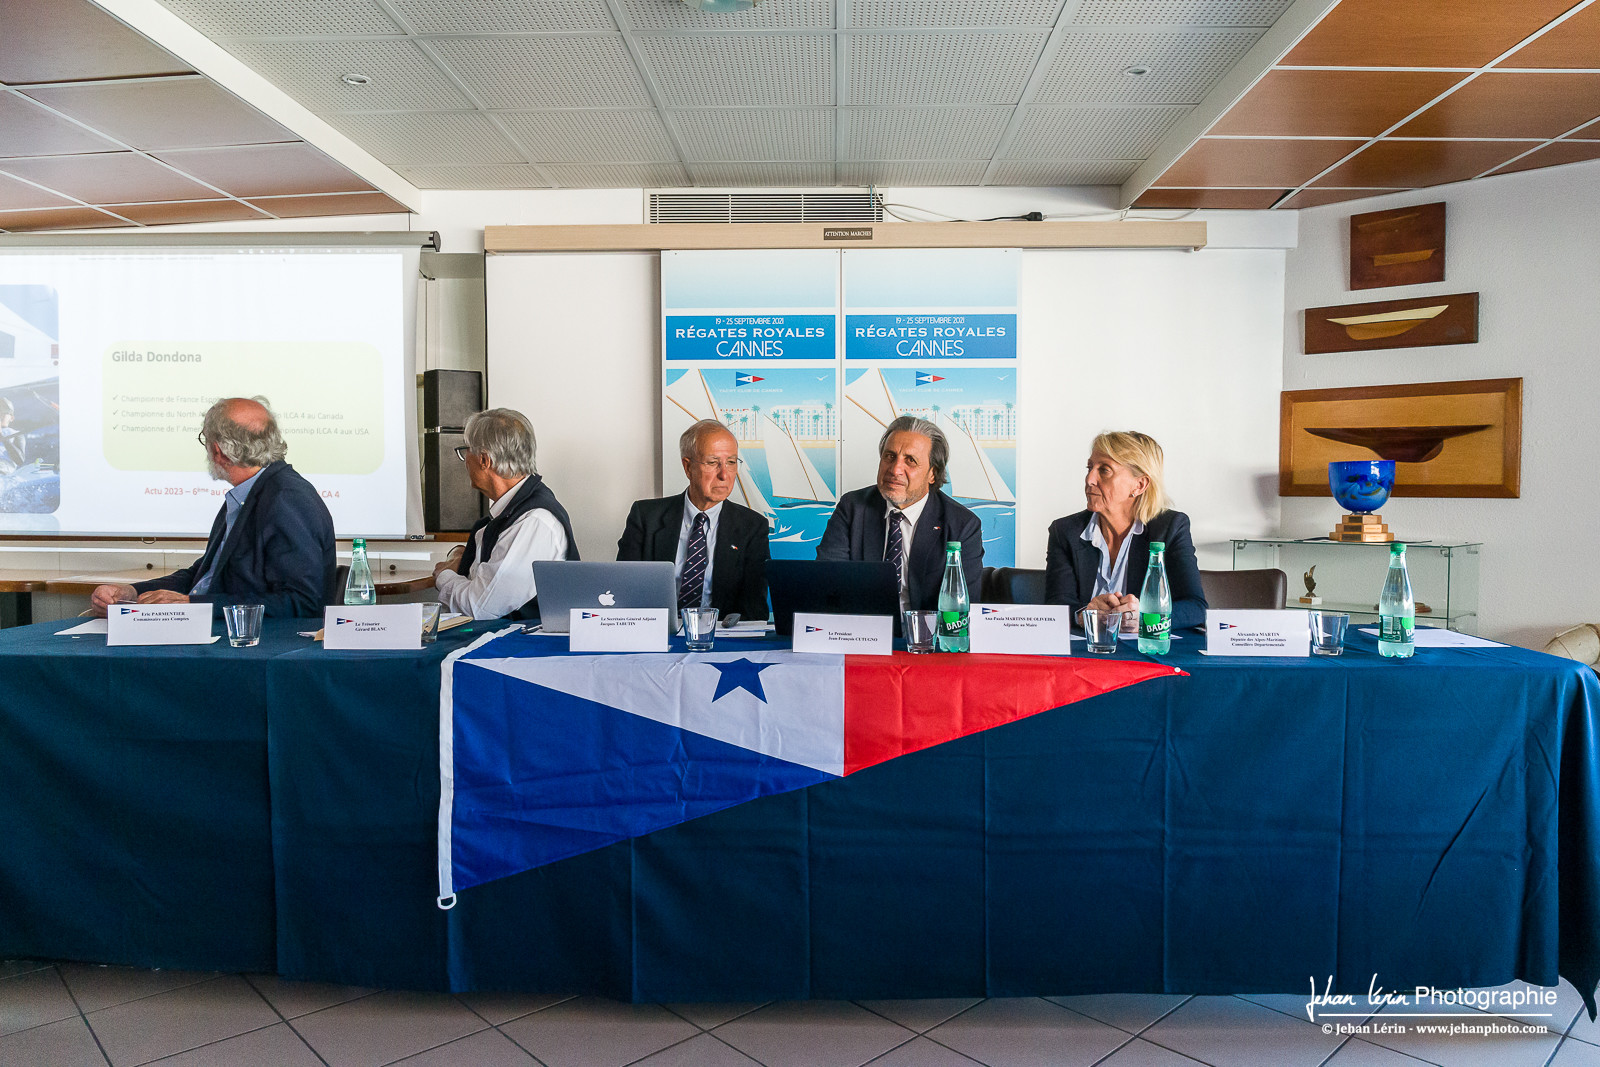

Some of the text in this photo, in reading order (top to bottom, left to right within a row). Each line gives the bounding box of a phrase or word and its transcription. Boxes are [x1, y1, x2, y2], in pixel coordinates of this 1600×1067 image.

[715, 317, 721, 325] 19
[726, 317, 734, 325] 25
[734, 317, 771, 325] SEPTEMBRE
[772, 317, 784, 325] 2021
[953, 316, 965, 324] 2021
[675, 325, 825, 338] RÉGATES ROYALES
[855, 324, 1006, 338] RÉGATES ROYALES
[716, 340, 784, 357] CANNES
[896, 340, 964, 356] CANNES
[112, 351, 202, 362] Gilda Dondona
[121, 396, 164, 404] Championne
[121, 410, 164, 419] Championne
[317, 412, 344, 420] Canada
[121, 425, 164, 433] Championne
